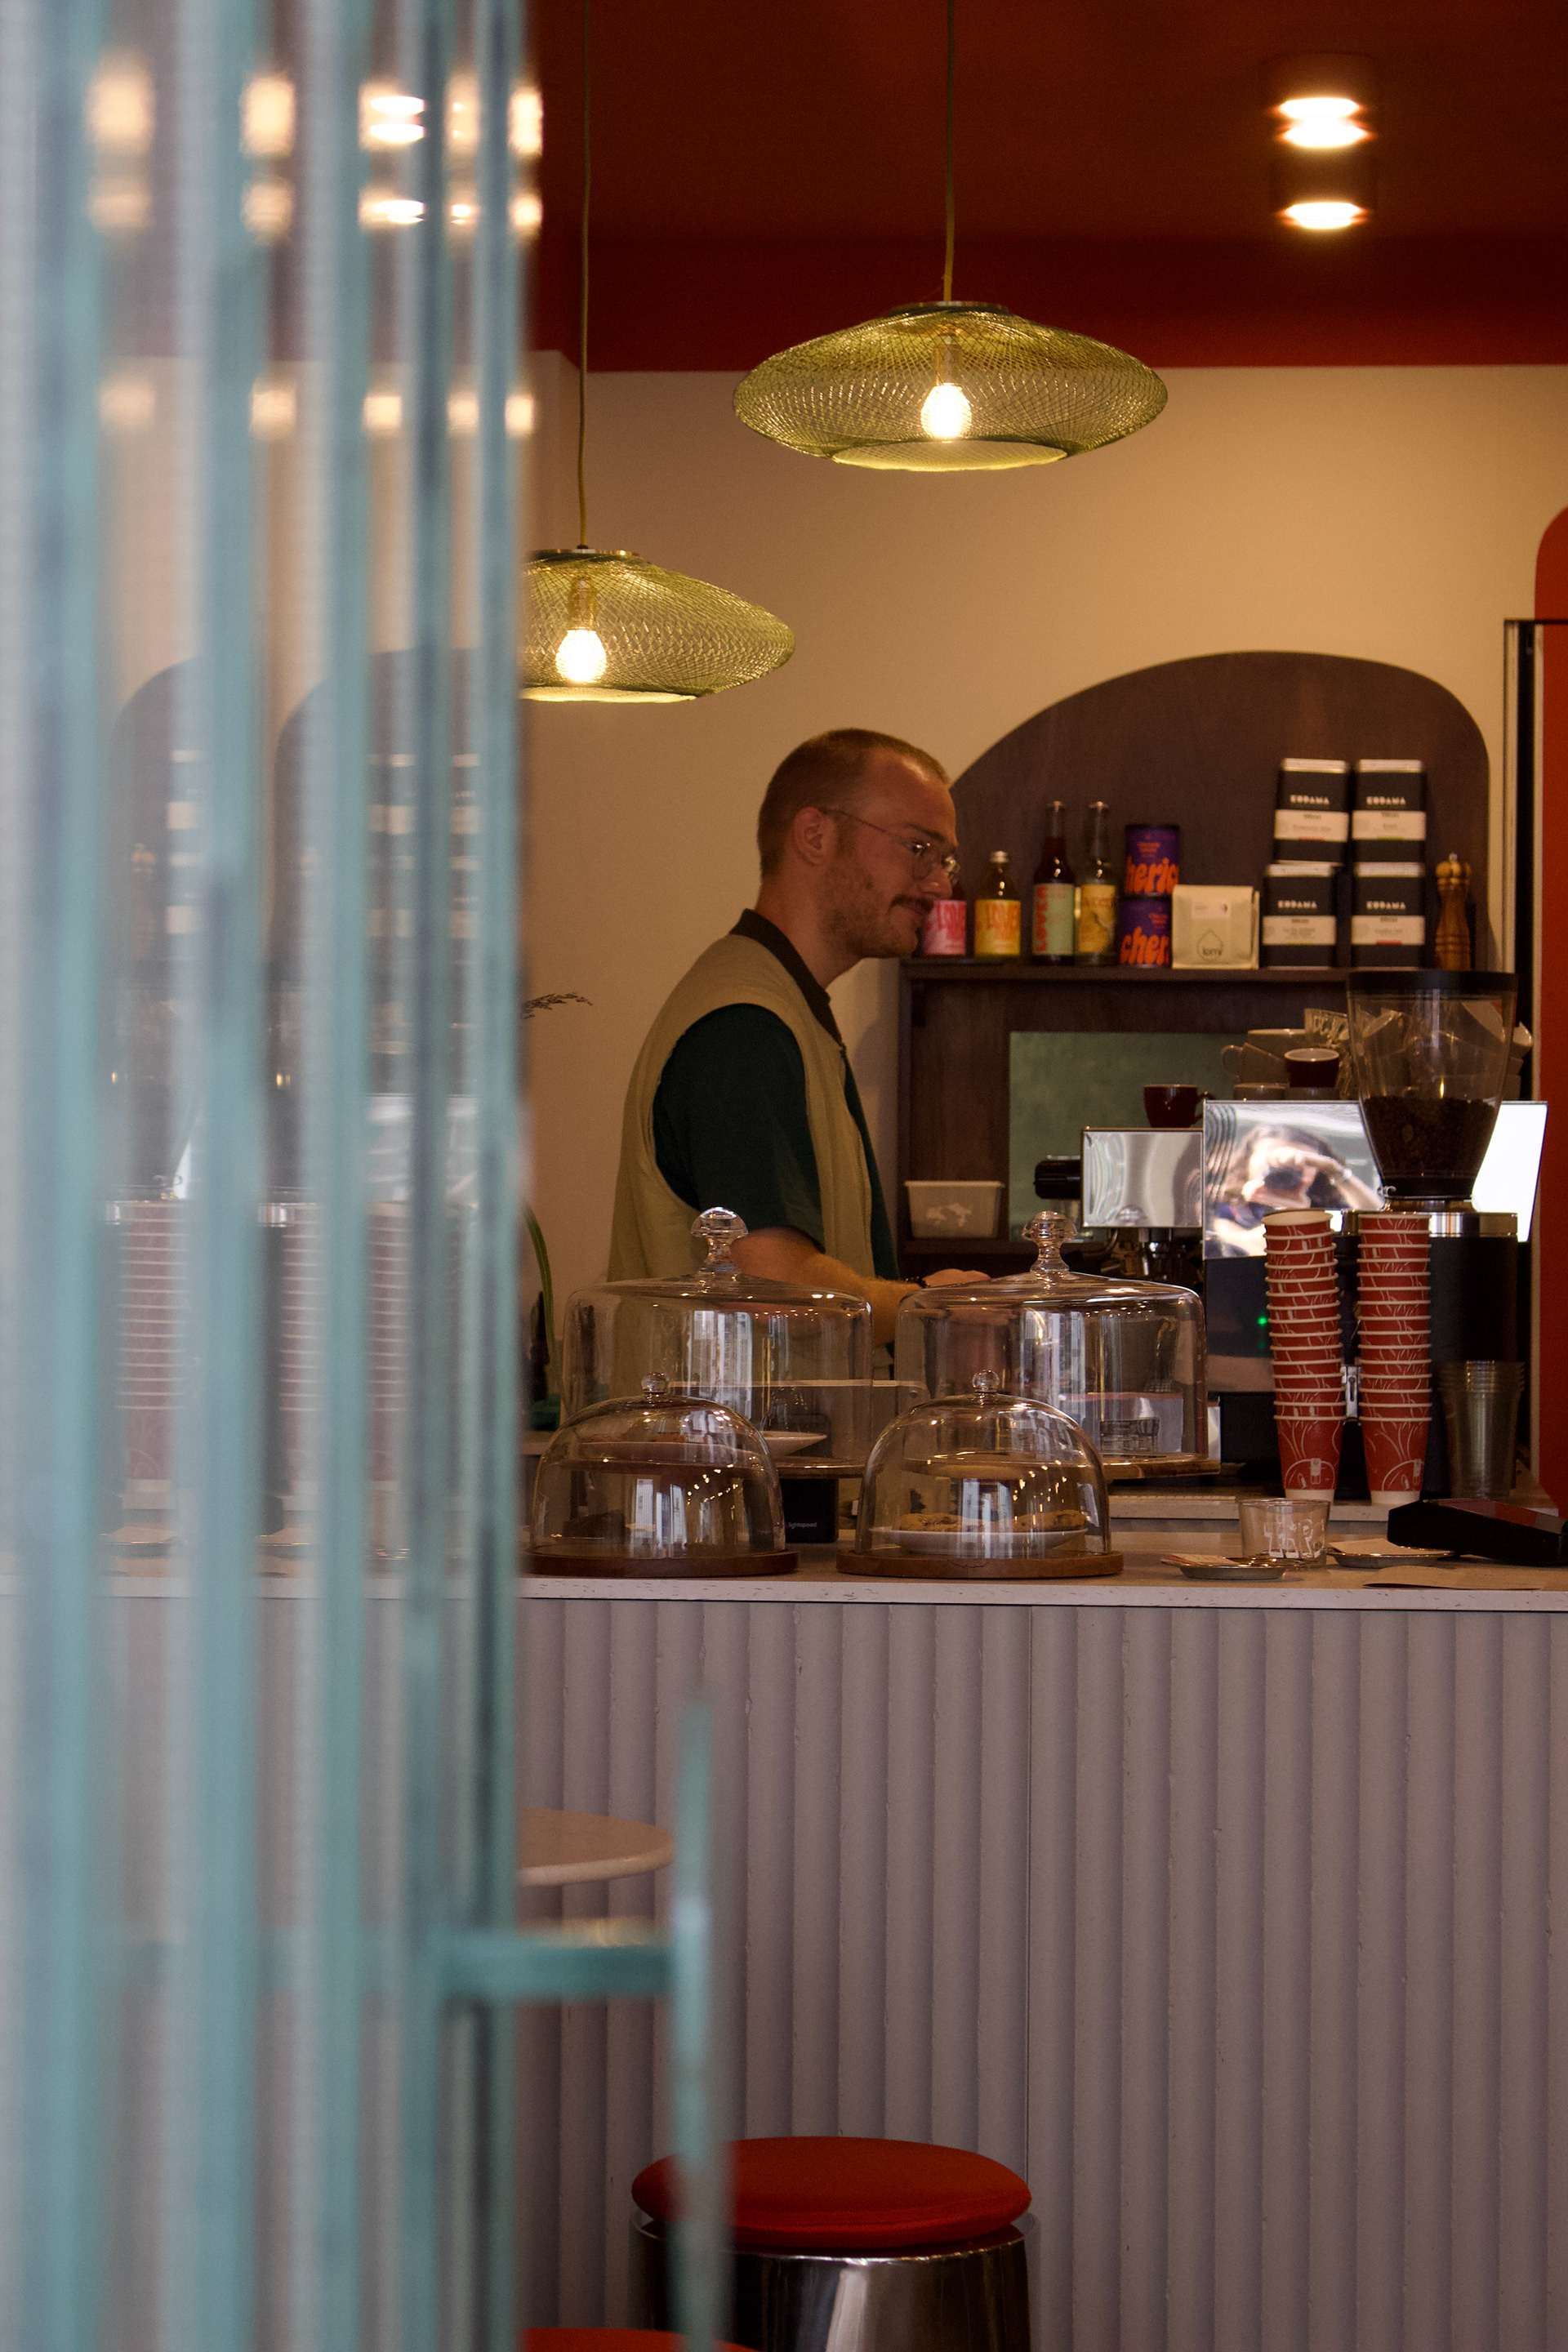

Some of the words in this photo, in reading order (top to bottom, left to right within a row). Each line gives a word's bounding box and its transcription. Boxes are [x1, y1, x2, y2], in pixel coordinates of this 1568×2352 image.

[1290, 794, 1330, 805] KODAMA
[1366, 795, 1406, 805] KODAMA
[1277, 900, 1317, 909] KODAMA
[1366, 901, 1406, 910] KODAMA
